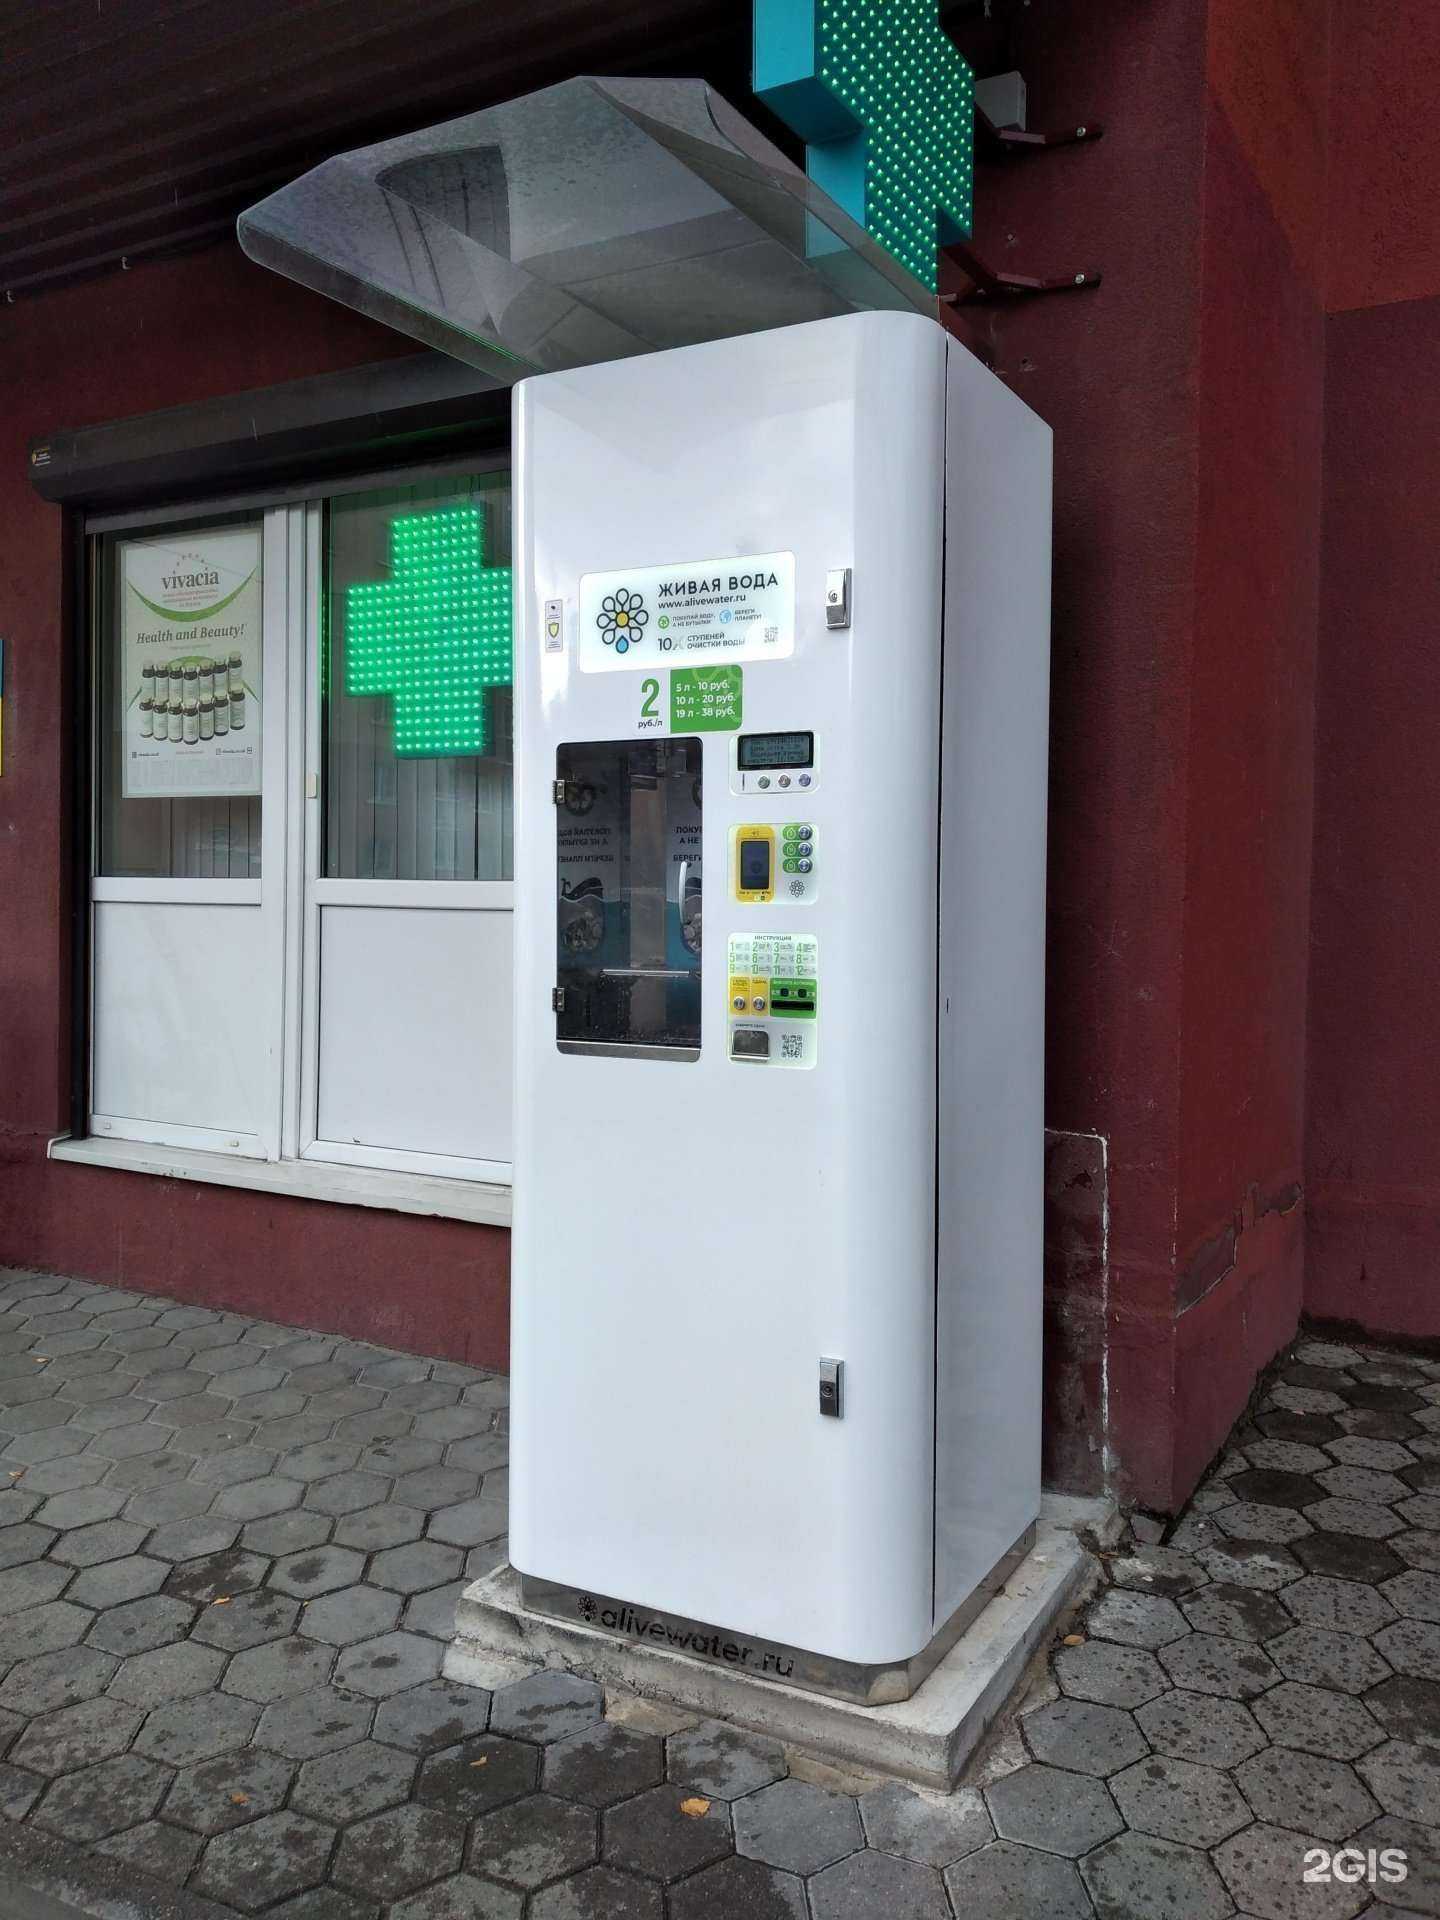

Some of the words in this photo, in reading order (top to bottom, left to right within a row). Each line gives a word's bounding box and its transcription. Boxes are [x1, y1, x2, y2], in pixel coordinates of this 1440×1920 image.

[161, 567, 220, 590] vivacia
[658, 578, 721, 598] ЖИВАЯ
[728, 572, 778, 591] ВОДА
[658, 594, 746, 609] www.alivewater.ru
[136, 629, 173, 644] Health
[175, 627, 198, 641] and
[200, 623, 245, 639] Beauty!
[687, 632, 725, 642] СТУПЕНЕЙ
[658, 637, 673, 651] 10
[687, 640, 721, 650] ОЧИСТКИ
[676, 683, 682, 692] 5
[684, 684, 690, 692] л
[698, 681, 708, 690] 10
[710, 679, 730, 691] руб.
[641, 678, 660, 718] 2
[676, 696, 686, 705] 10
[688, 697, 694, 705] л
[702, 694, 714, 703] 20
[716, 692, 736, 704] руб.
[676, 709, 686, 718] 19
[687, 710, 694, 718] л
[701, 707, 713, 717] 38
[716, 706, 735, 718] руб.
[638, 719, 663, 729] руб./л
[752, 942, 758, 952] 2
[773, 942, 780, 952] 3
[796, 942, 802, 952] 4
[773, 953, 780, 963] 7
[600, 1606, 795, 1677] alivewater.ru
